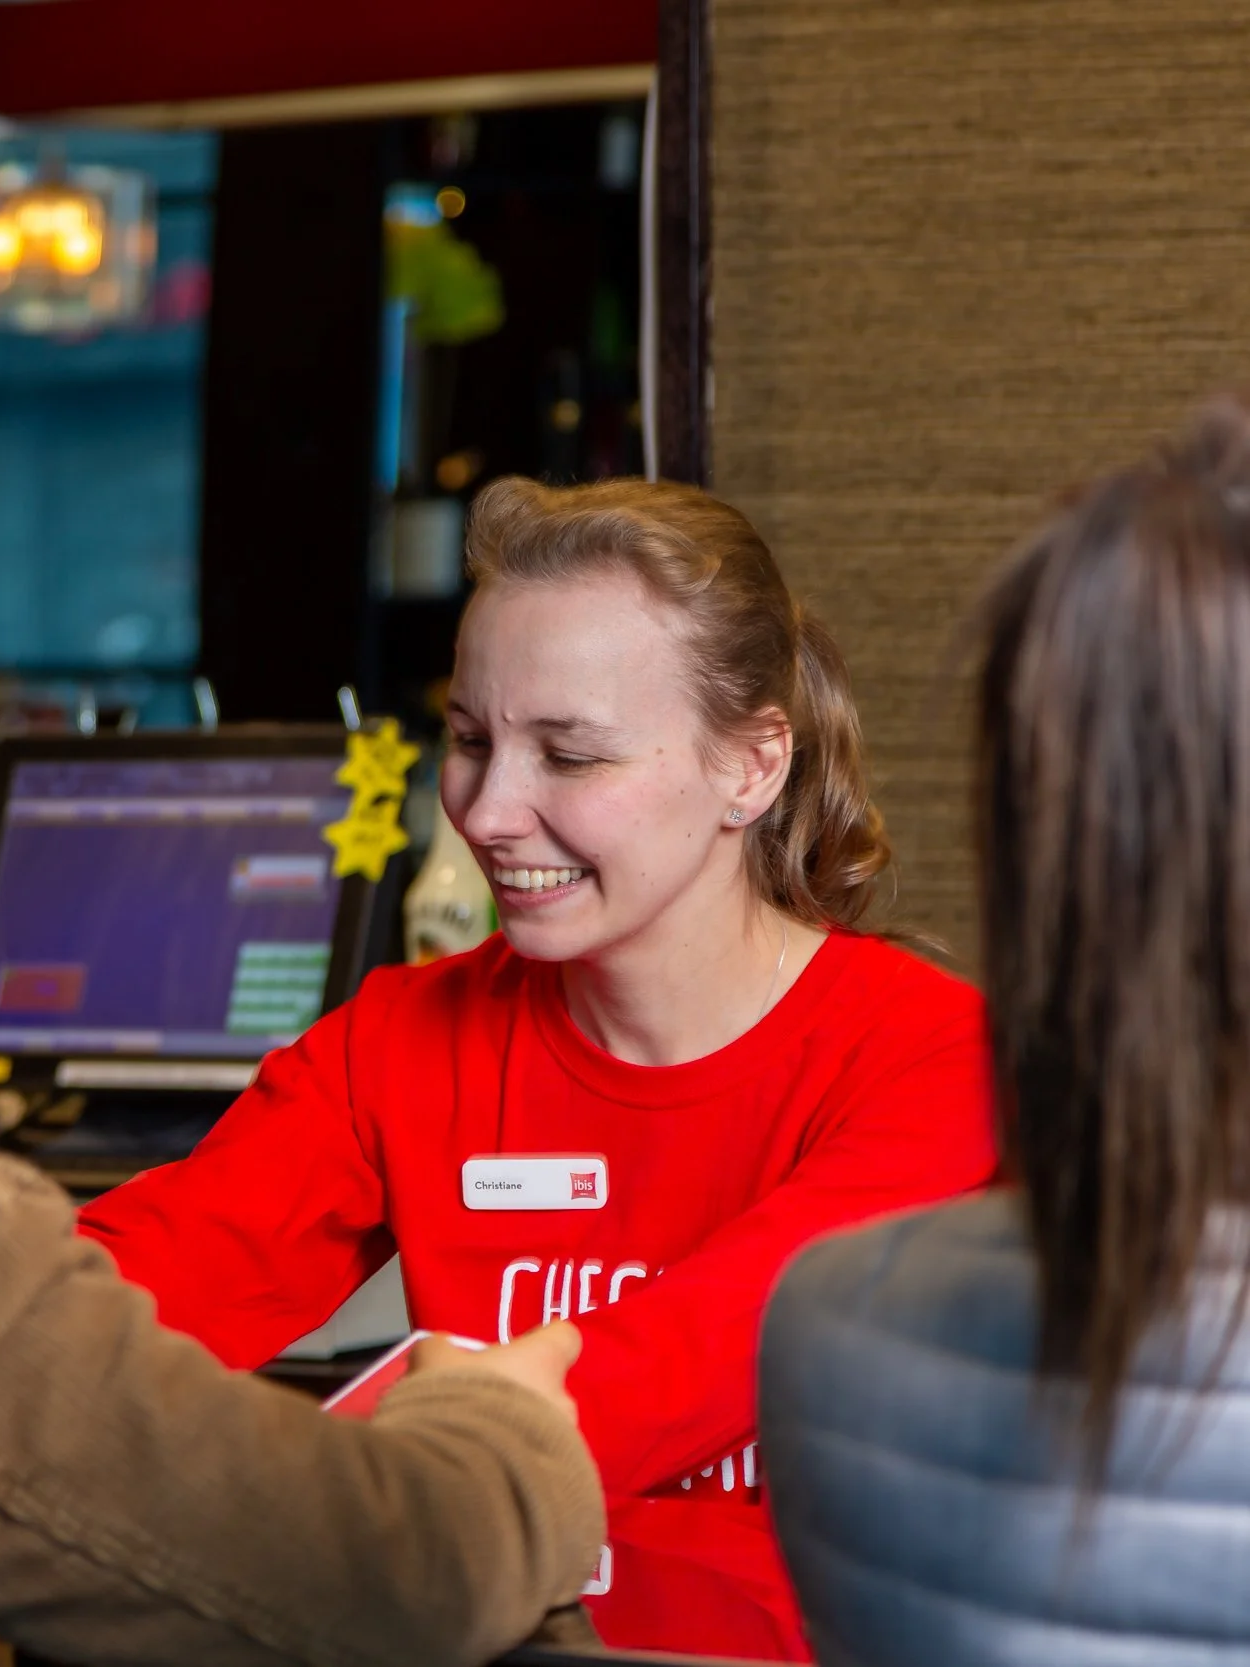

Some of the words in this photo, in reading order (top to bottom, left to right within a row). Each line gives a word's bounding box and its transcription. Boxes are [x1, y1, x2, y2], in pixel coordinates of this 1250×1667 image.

[474, 1180, 522, 1190] Christiane
[574, 1179, 593, 1190] ibis
[498, 1256, 665, 1345] CHE
